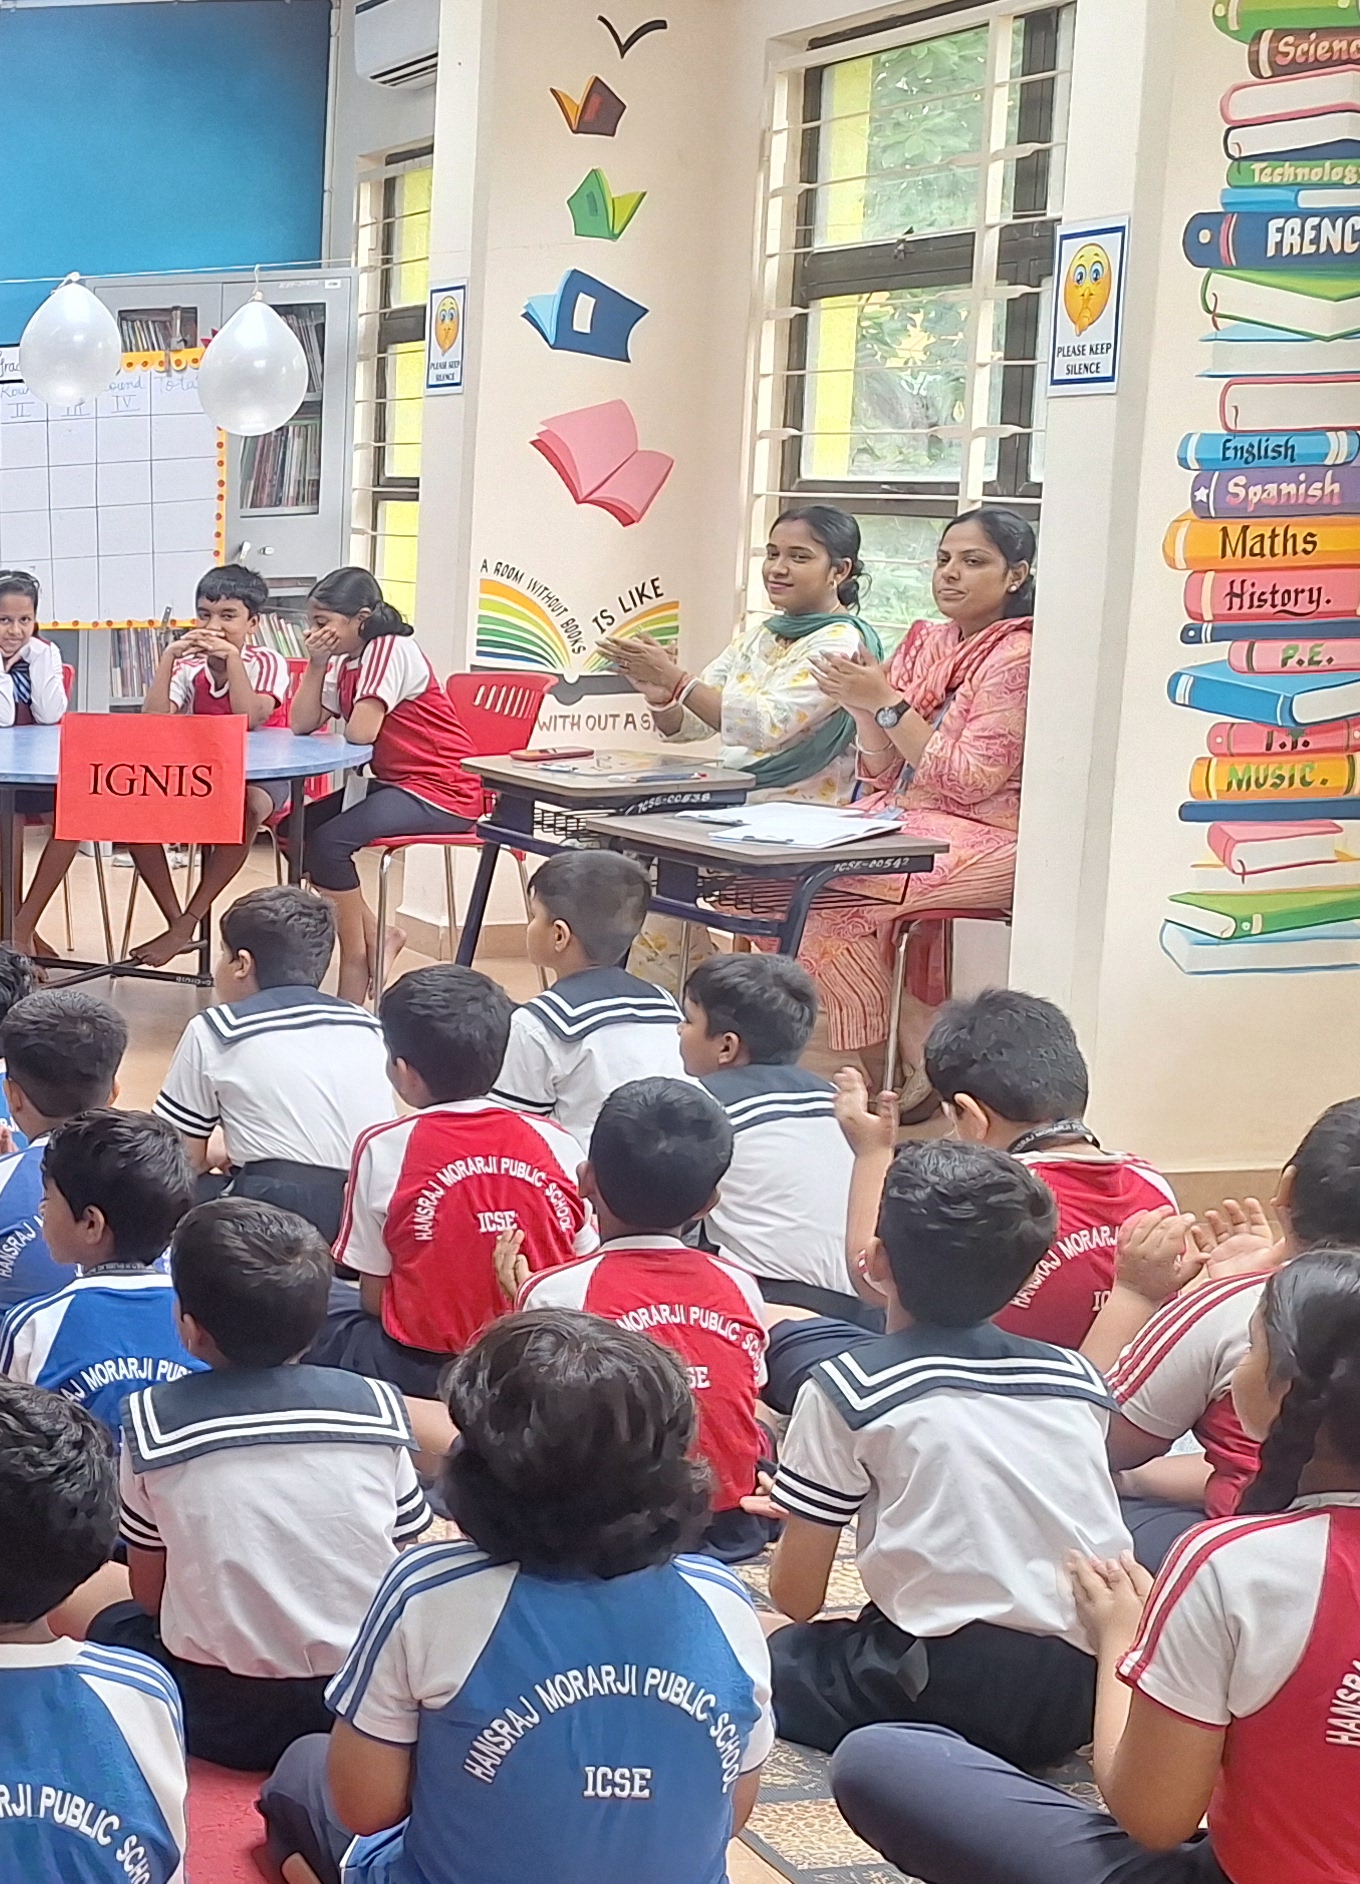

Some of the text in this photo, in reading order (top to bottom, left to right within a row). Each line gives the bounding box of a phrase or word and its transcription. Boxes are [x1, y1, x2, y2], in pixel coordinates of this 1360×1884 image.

[1275, 32, 1360, 66] Scienc
[1266, 215, 1360, 258] FRENC
[1056, 342, 1112, 358] PLEASE KEEP
[104, 375, 146, 392] ound
[153, 375, 199, 393] Tota
[1065, 361, 1101, 376] SILENCE
[1220, 435, 1297, 466] English
[1225, 468, 1342, 507] Spanish
[1218, 524, 1319, 561] Maths
[480, 558, 665, 655] A ROOM WITHOUT BOOKS IS LIKE
[1280, 643, 1335, 668] P.E.
[88, 763, 213, 798] IGNIS
[413, 1155, 574, 1241] HANSRAJ MORARJI PUBLIC SCHOOL
[476, 1210, 518, 1233] ICSE
[1056, 1225, 1121, 1261] MORARJ
[615, 1303, 686, 1333] MORARJI
[688, 1306, 741, 1341] PUBLIC
[80, 1357, 153, 1392] MORARJI
[1325, 1660, 1360, 1747] HANSR
[463, 1663, 741, 1795] HANSRAJ MORARJI PUBLIC SCHOOL
[583, 1766, 652, 1799] ICSE
[39, 1785, 121, 1846] PUBLIC
[115, 1834, 152, 1884] SCHO
